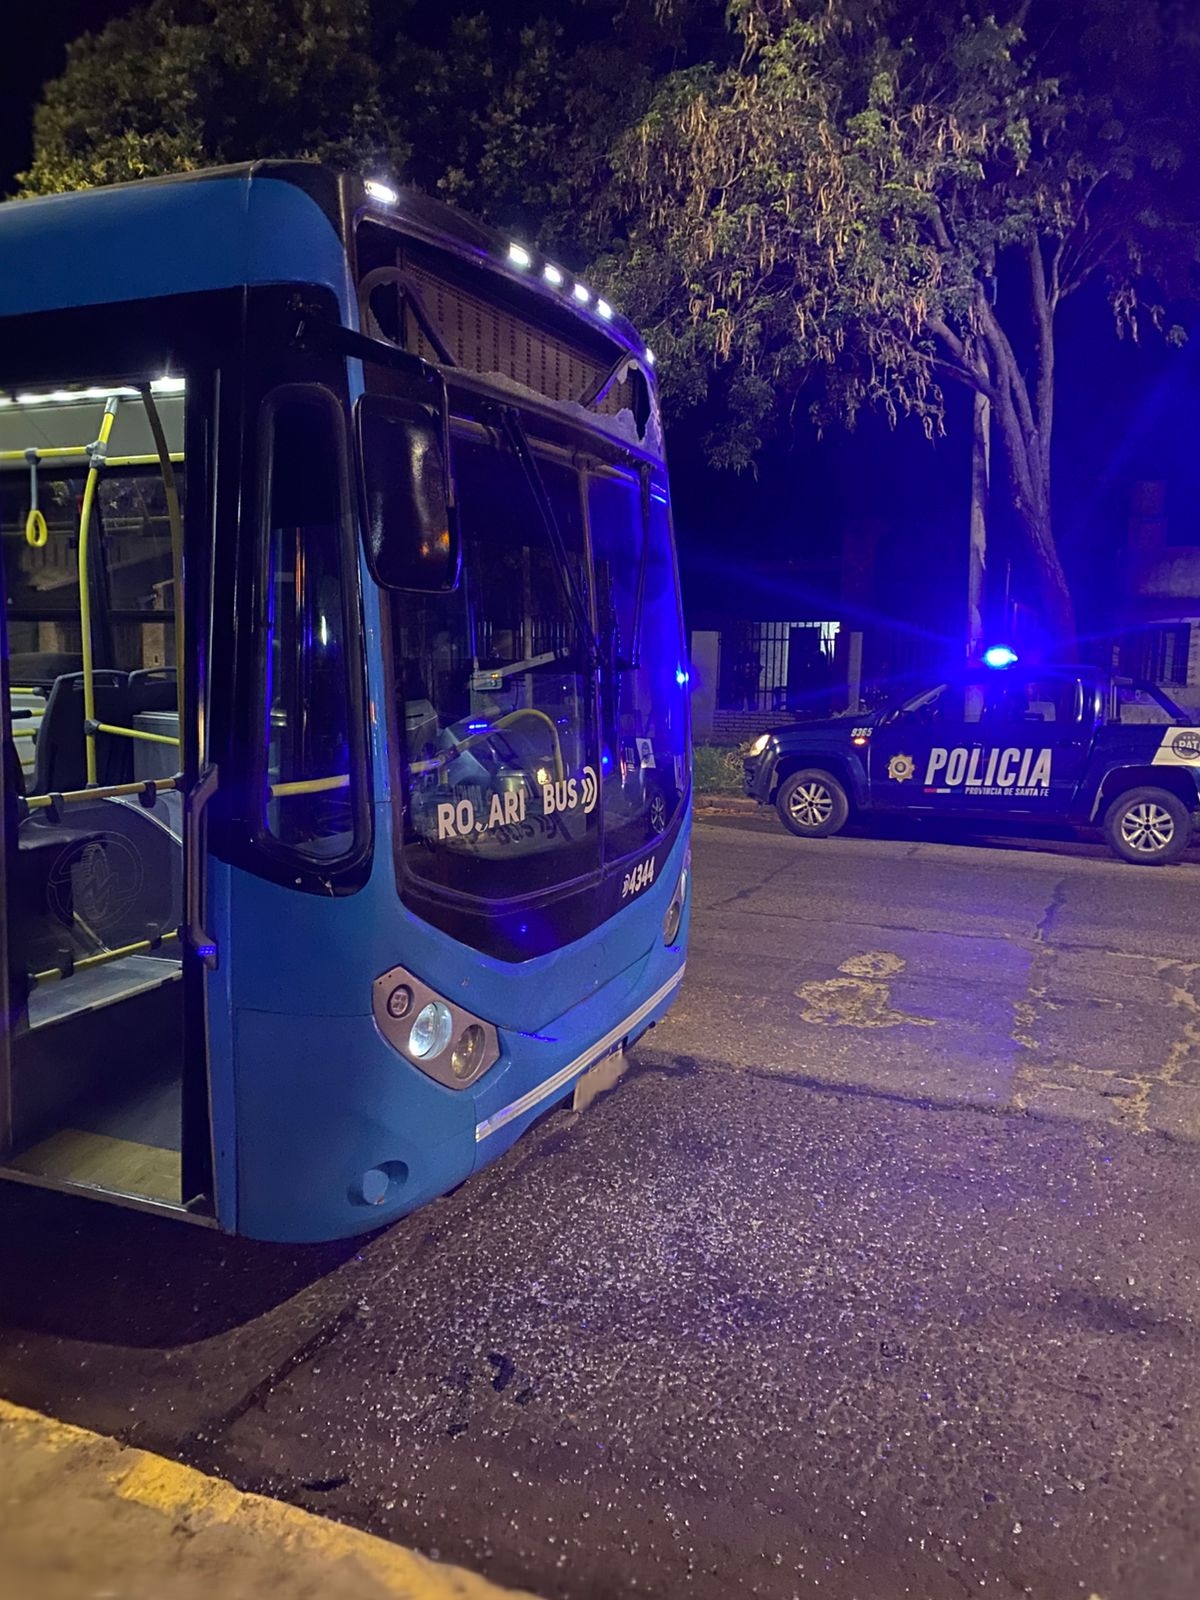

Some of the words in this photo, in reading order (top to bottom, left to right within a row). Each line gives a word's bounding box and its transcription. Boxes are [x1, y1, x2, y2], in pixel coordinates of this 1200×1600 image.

[850, 727, 873, 737] 9365
[924, 747, 1052, 788] POLICIA
[543, 777, 578, 816] BUS
[964, 786, 1002, 796] PROVINCIA
[1003, 787, 1014, 796] DE
[1014, 787, 1039, 797] SANTA
[1039, 788, 1050, 797] FE
[629, 855, 656, 895] 4344
